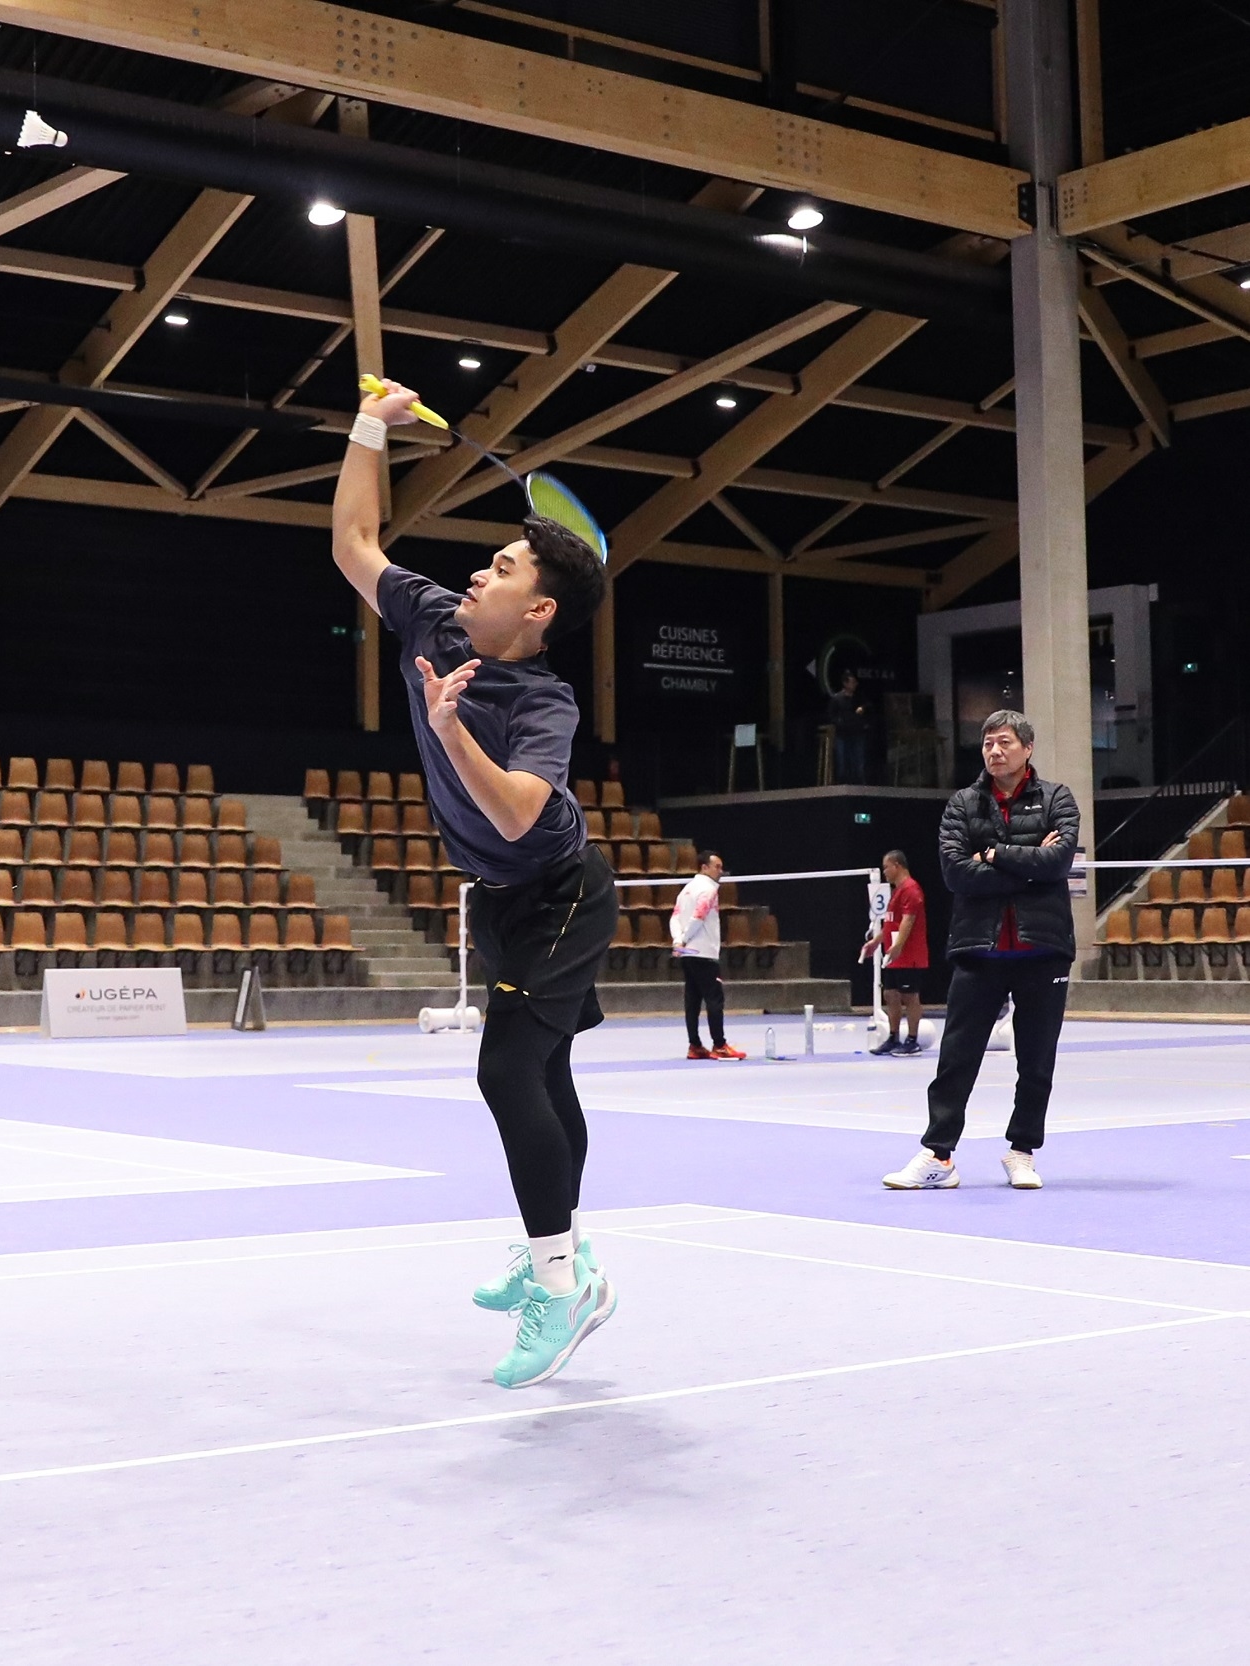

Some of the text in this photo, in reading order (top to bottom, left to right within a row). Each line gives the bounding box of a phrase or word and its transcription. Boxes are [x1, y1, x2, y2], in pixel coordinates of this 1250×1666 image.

[659, 625, 718, 643] CUISINES
[652, 643, 725, 662] RÉFÉRENCE
[661, 676, 717, 692] CHAMBLY
[876, 894, 885, 911] 3
[89, 985, 158, 1001] UGÉPA
